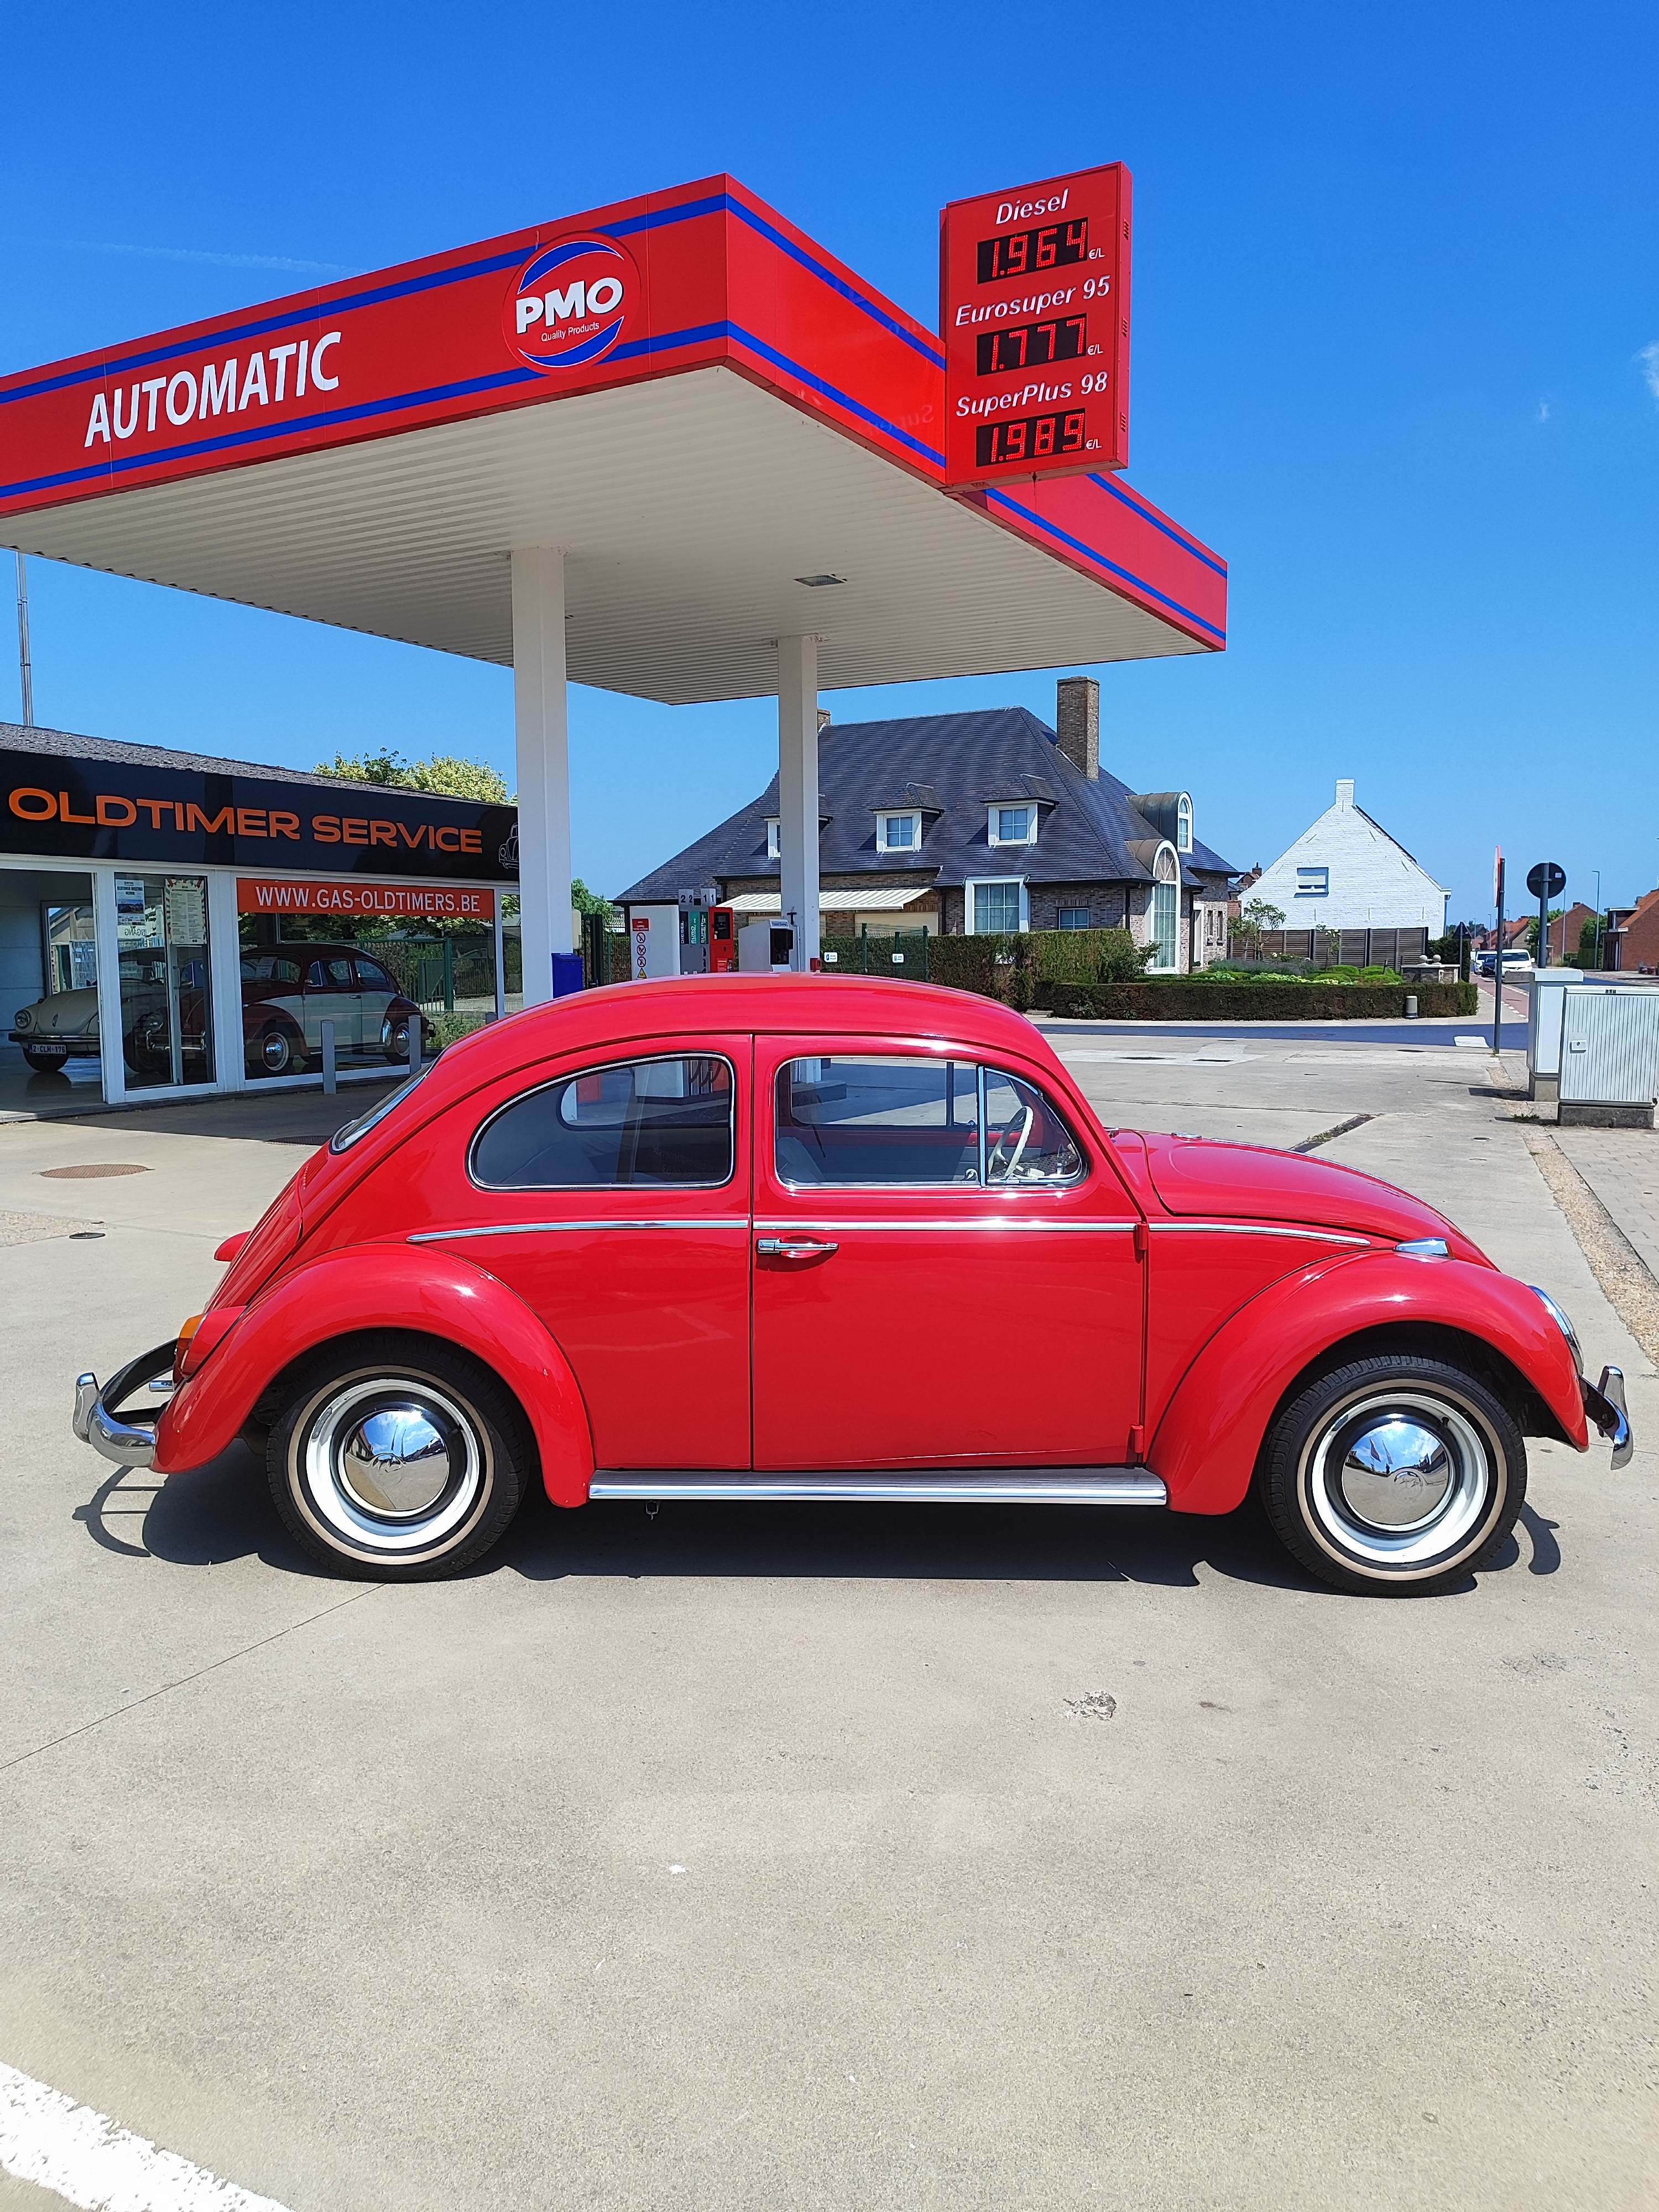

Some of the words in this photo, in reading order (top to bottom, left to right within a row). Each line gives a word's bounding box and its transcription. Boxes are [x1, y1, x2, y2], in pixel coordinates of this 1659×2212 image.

[996, 188, 1069, 225] Diesel
[992, 221, 1087, 278] 1.964
[1088, 247, 1105, 260] €/L
[515, 276, 624, 334] PMO
[954, 285, 1077, 327] Eurosuper
[1082, 274, 1111, 301] 95
[541, 330, 566, 342] Quality
[568, 321, 600, 336] Products
[991, 317, 1086, 371] 1.777
[1087, 343, 1104, 357] €/L
[84, 331, 342, 448] AUTOMATIC
[956, 379, 1072, 418] SuperPlus
[1080, 371, 1108, 394] 98
[990, 413, 1085, 463] 1.989
[1086, 439, 1102, 451] €/L
[8, 787, 301, 841] OLDTIMER
[312, 815, 483, 853] SERVICE
[255, 886, 481, 912] WWW.GAS-OLDTIMERS.BE
[680, 895, 686, 903] 2
[703, 894, 707, 902] 1
[711, 894, 714, 902] 1
